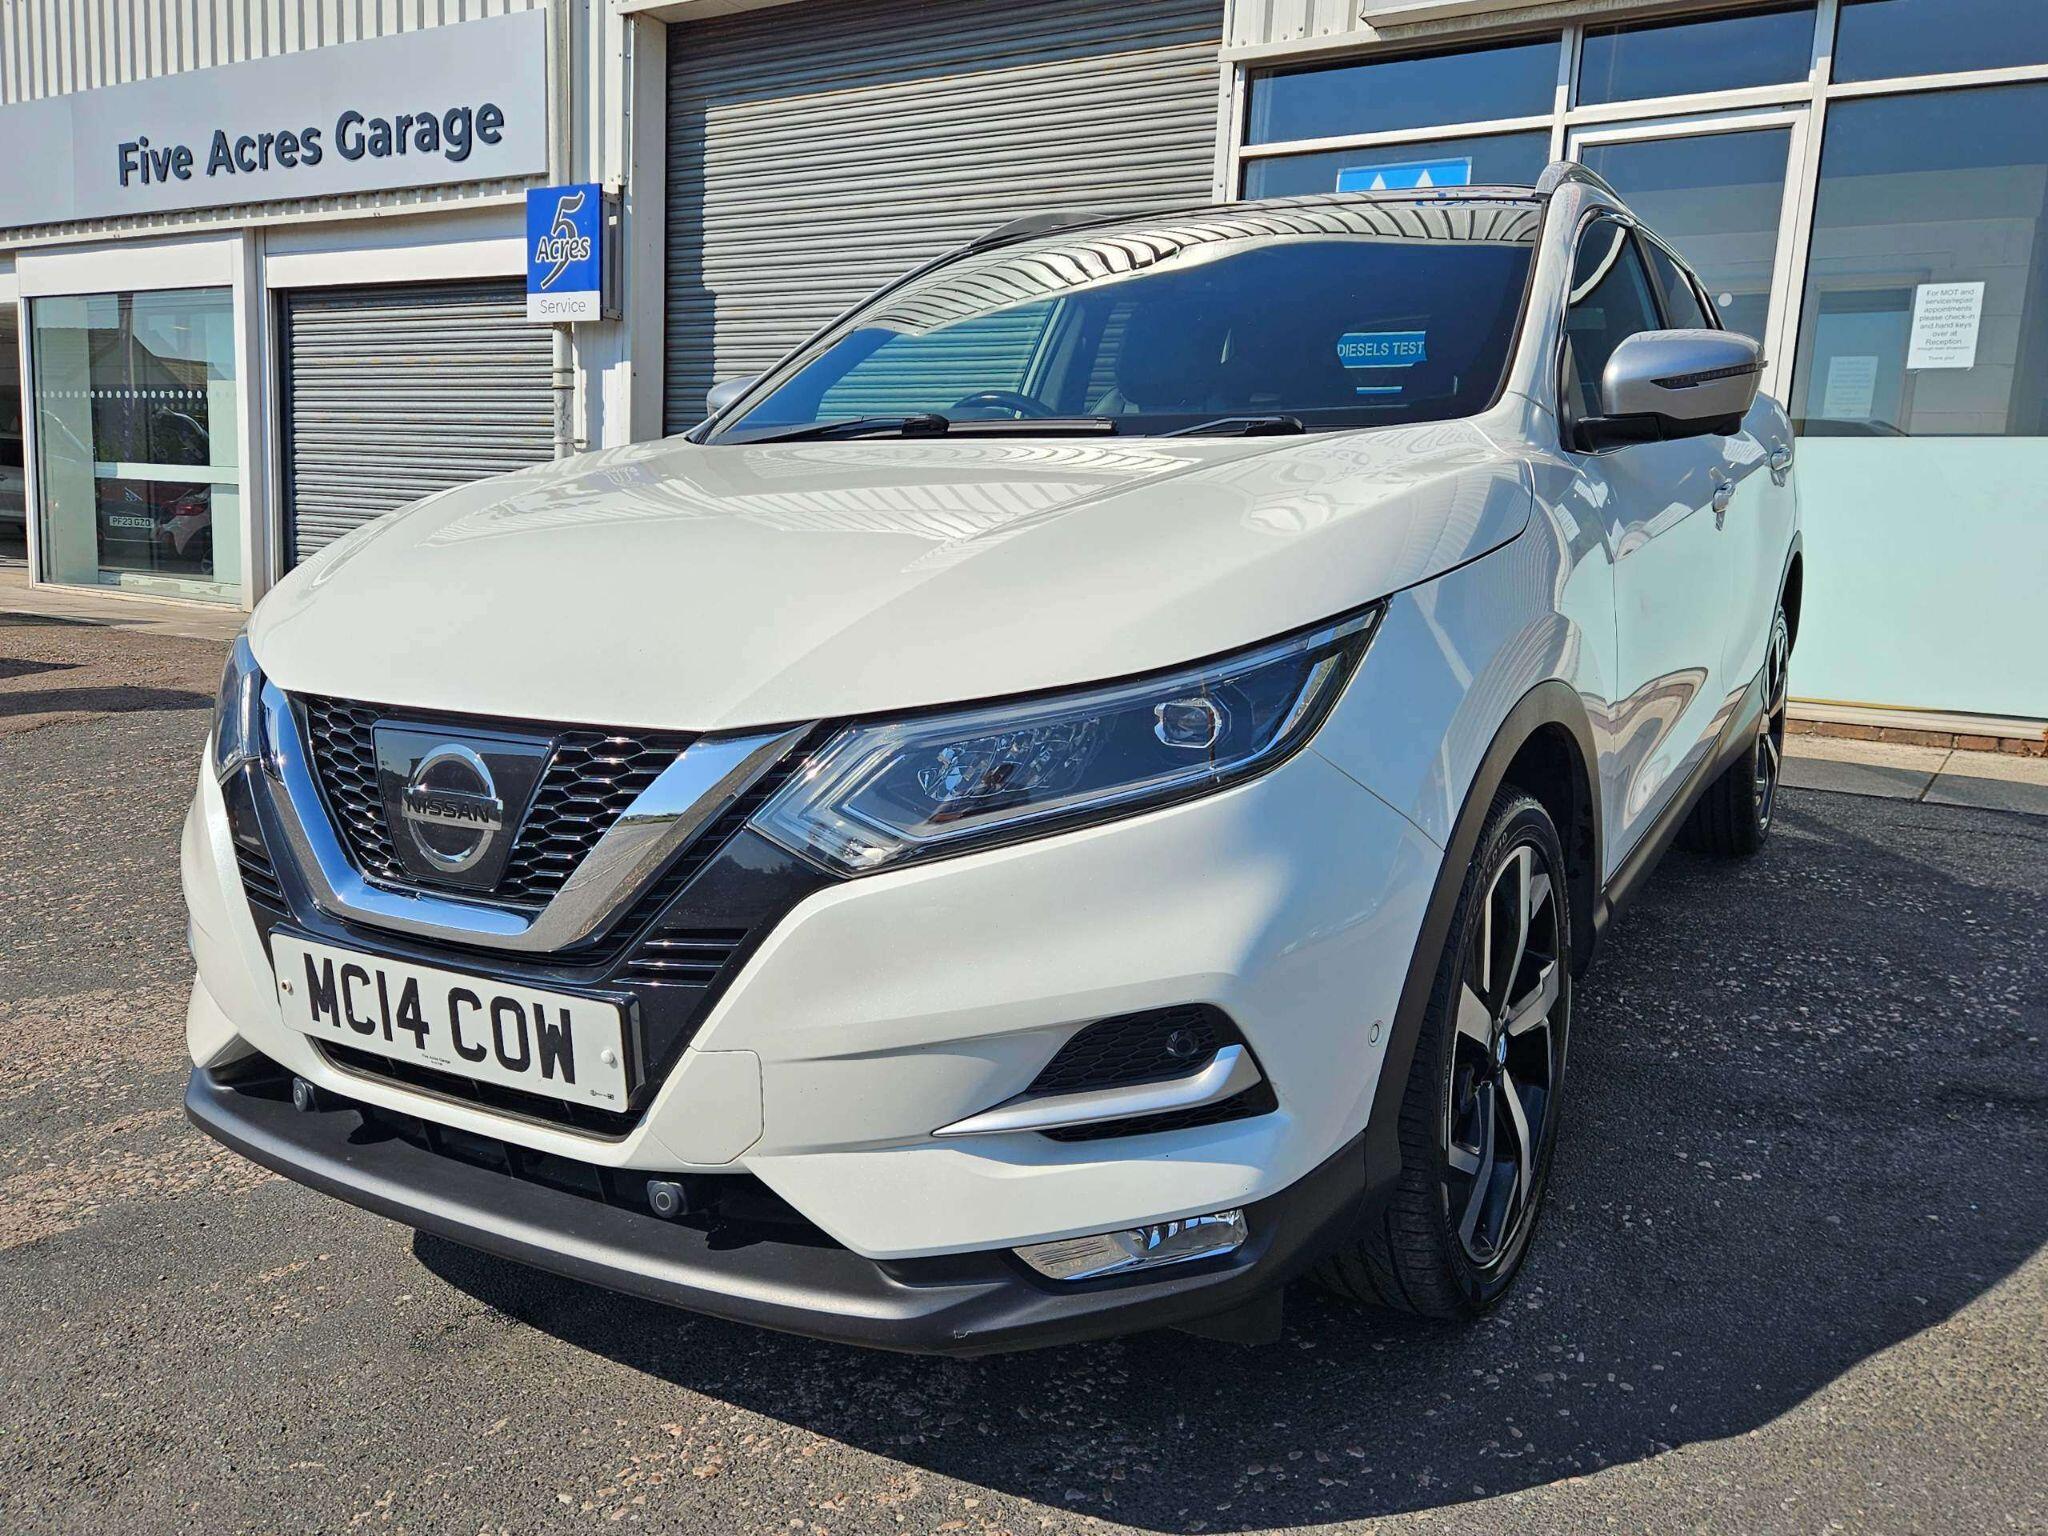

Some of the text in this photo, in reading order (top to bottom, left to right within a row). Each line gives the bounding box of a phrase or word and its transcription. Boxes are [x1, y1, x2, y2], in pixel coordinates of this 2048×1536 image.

[118, 102, 505, 187] Five Acres Garage
[536, 237, 590, 263] Acres
[540, 298, 586, 314] Service
[1337, 342, 1389, 357] DIESELS
[112, 517, 133, 526] PF23
[405, 796, 490, 824] NISSAN
[303, 952, 576, 1085] MC14 COW
